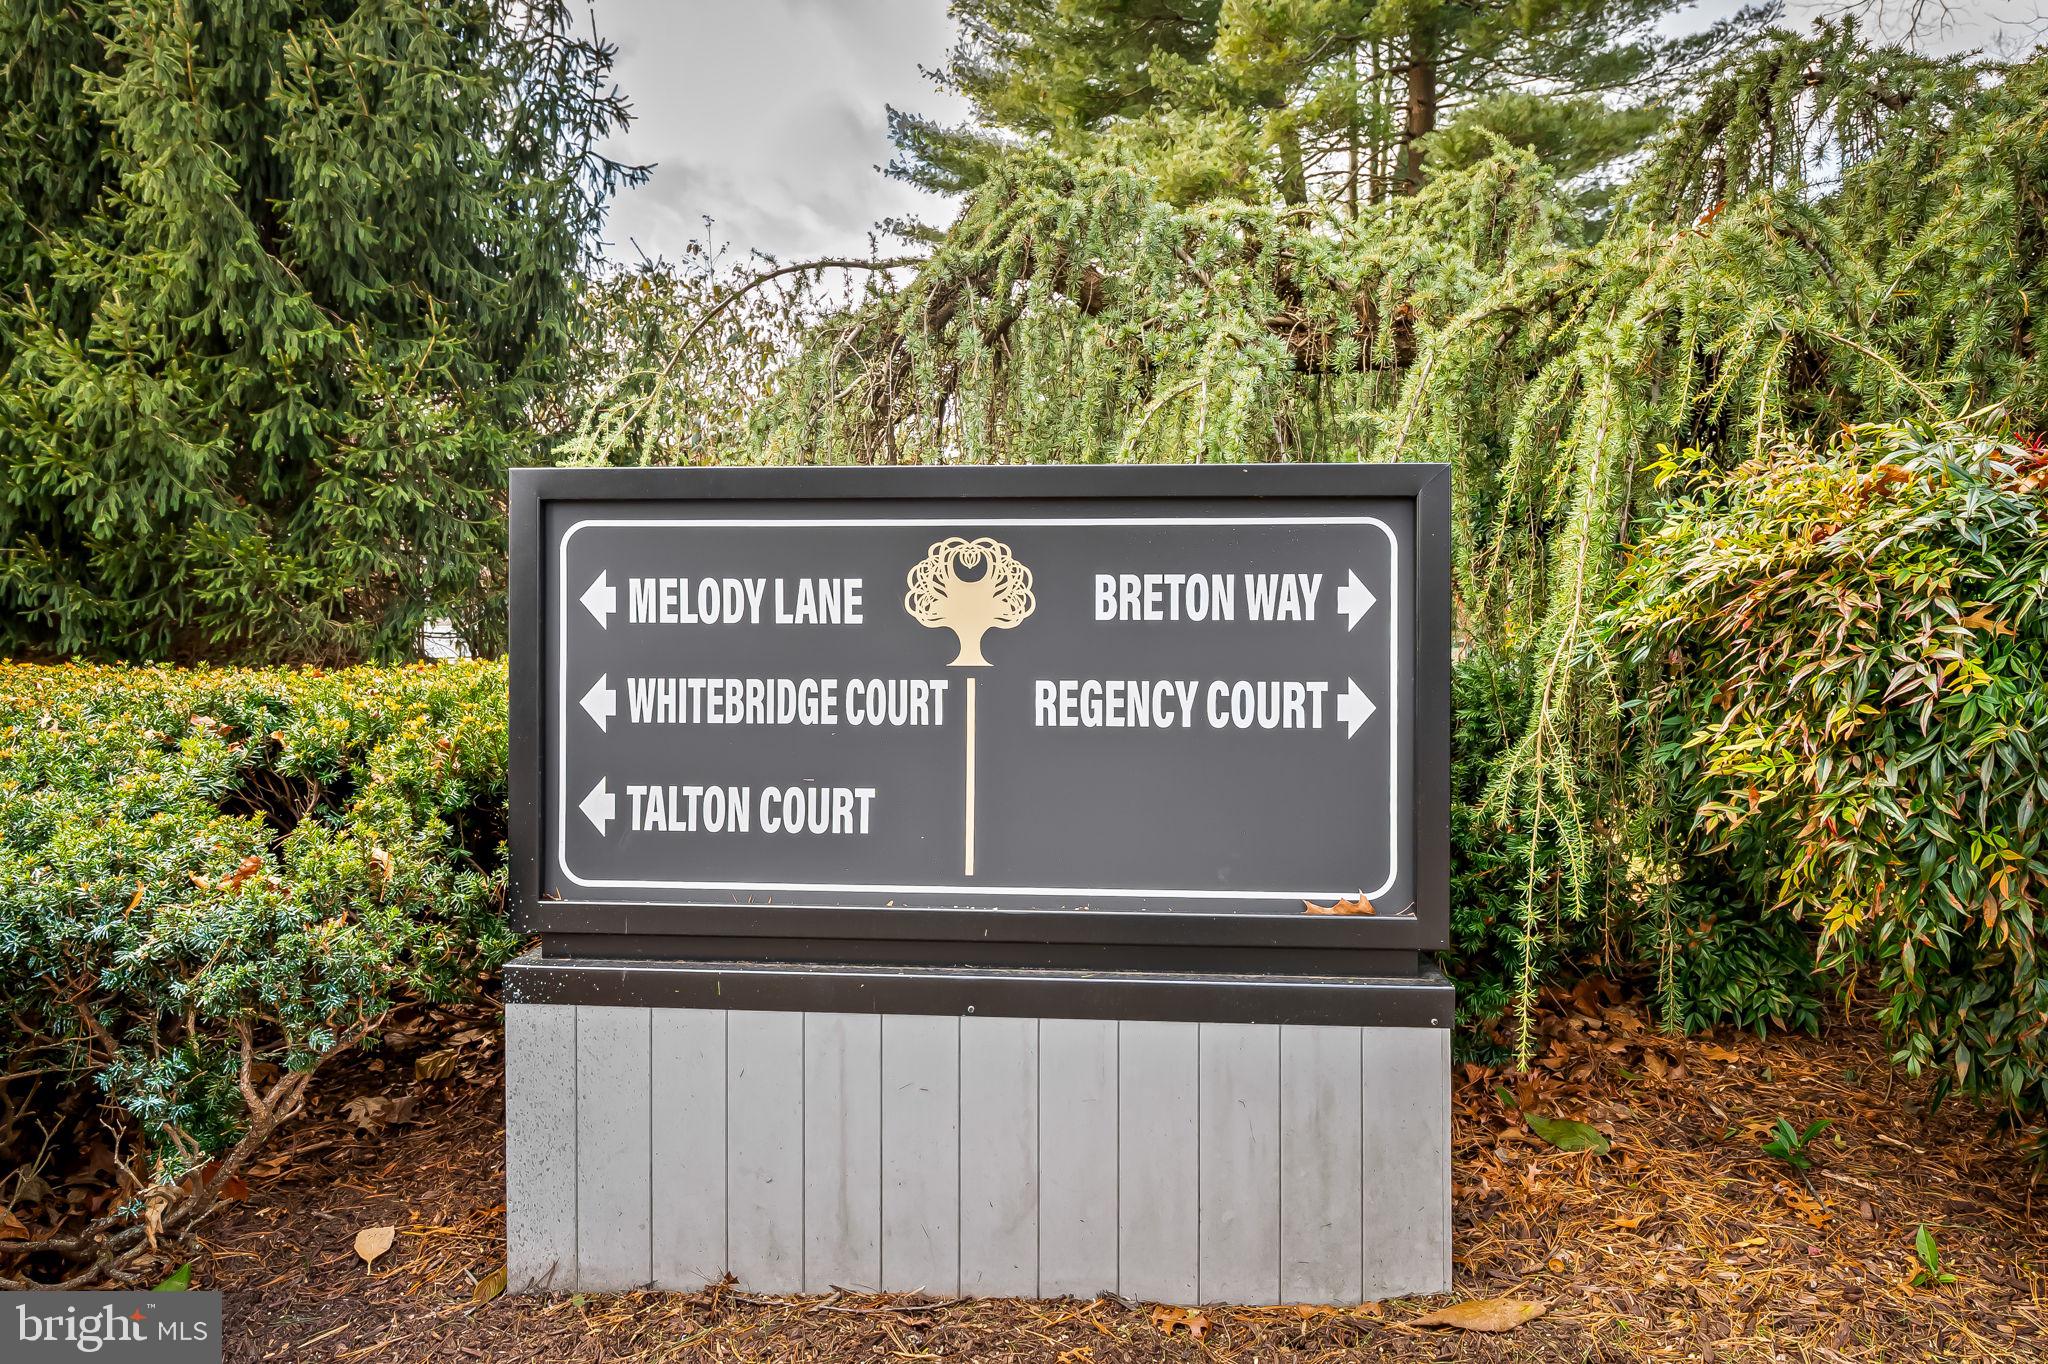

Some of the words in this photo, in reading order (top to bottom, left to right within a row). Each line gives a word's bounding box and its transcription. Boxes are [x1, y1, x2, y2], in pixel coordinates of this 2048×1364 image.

[628, 577, 767, 625] MELODY
[774, 577, 864, 625] LANE
[1094, 573, 1235, 622] BRETON
[1244, 573, 1324, 622] WAY
[626, 677, 838, 726] WHITEBRIDGE
[845, 678, 949, 727] COURT
[1034, 679, 1200, 729] REGENCY
[1206, 679, 1329, 730] COURT
[626, 785, 751, 833] TALTON
[759, 786, 876, 835] COURT
